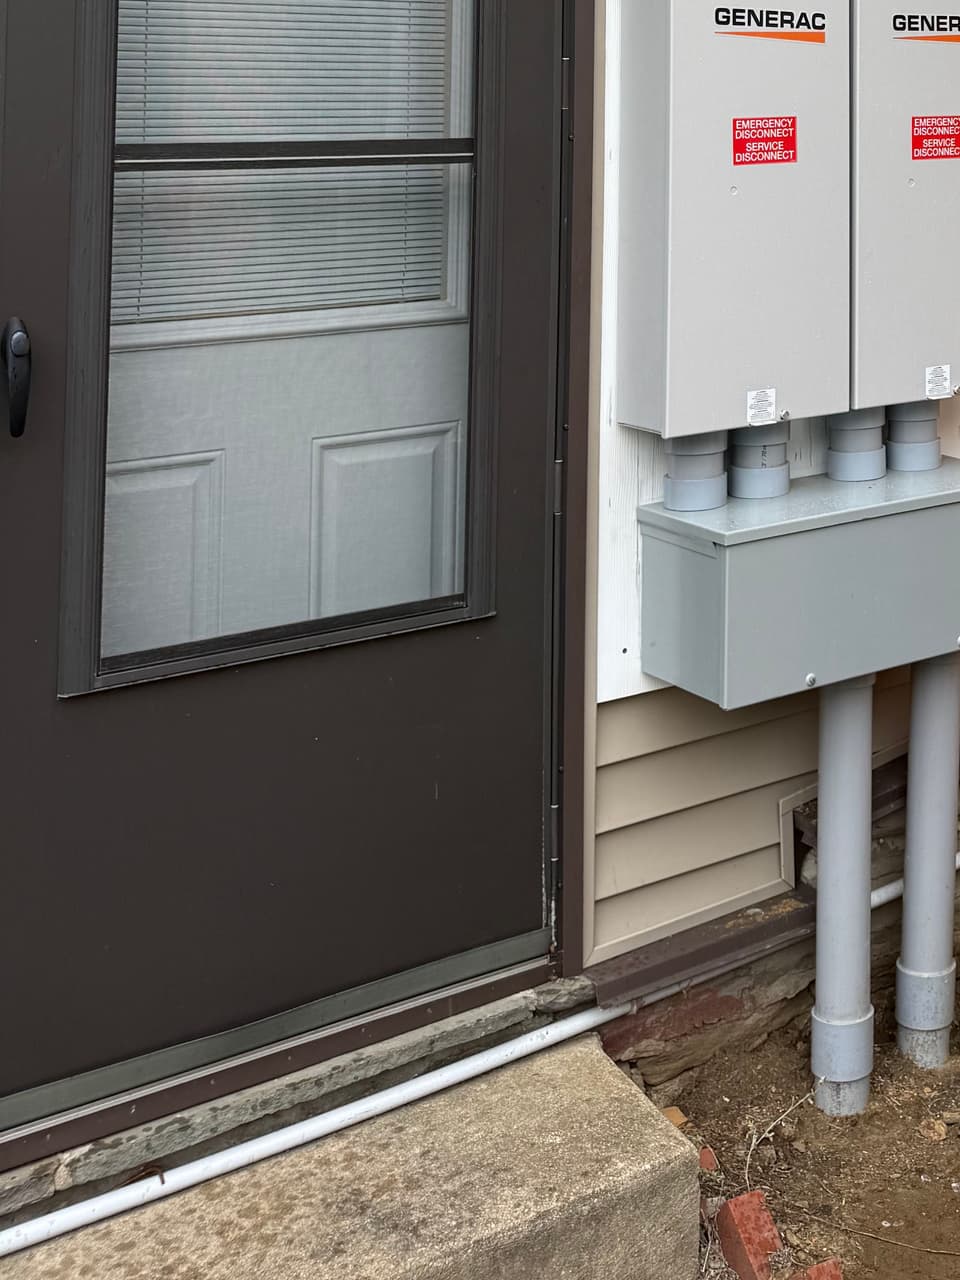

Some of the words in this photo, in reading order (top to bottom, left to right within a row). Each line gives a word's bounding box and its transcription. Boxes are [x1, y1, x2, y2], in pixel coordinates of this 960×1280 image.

[714, 7, 826, 30] GENERAC
[736, 118, 793, 129] EMERGENCY
[735, 128, 794, 139] DISCONNECT
[745, 141, 784, 152] SERVICE
[922, 138, 956, 148] SERVICE
[735, 150, 794, 162] DISCONNECT
